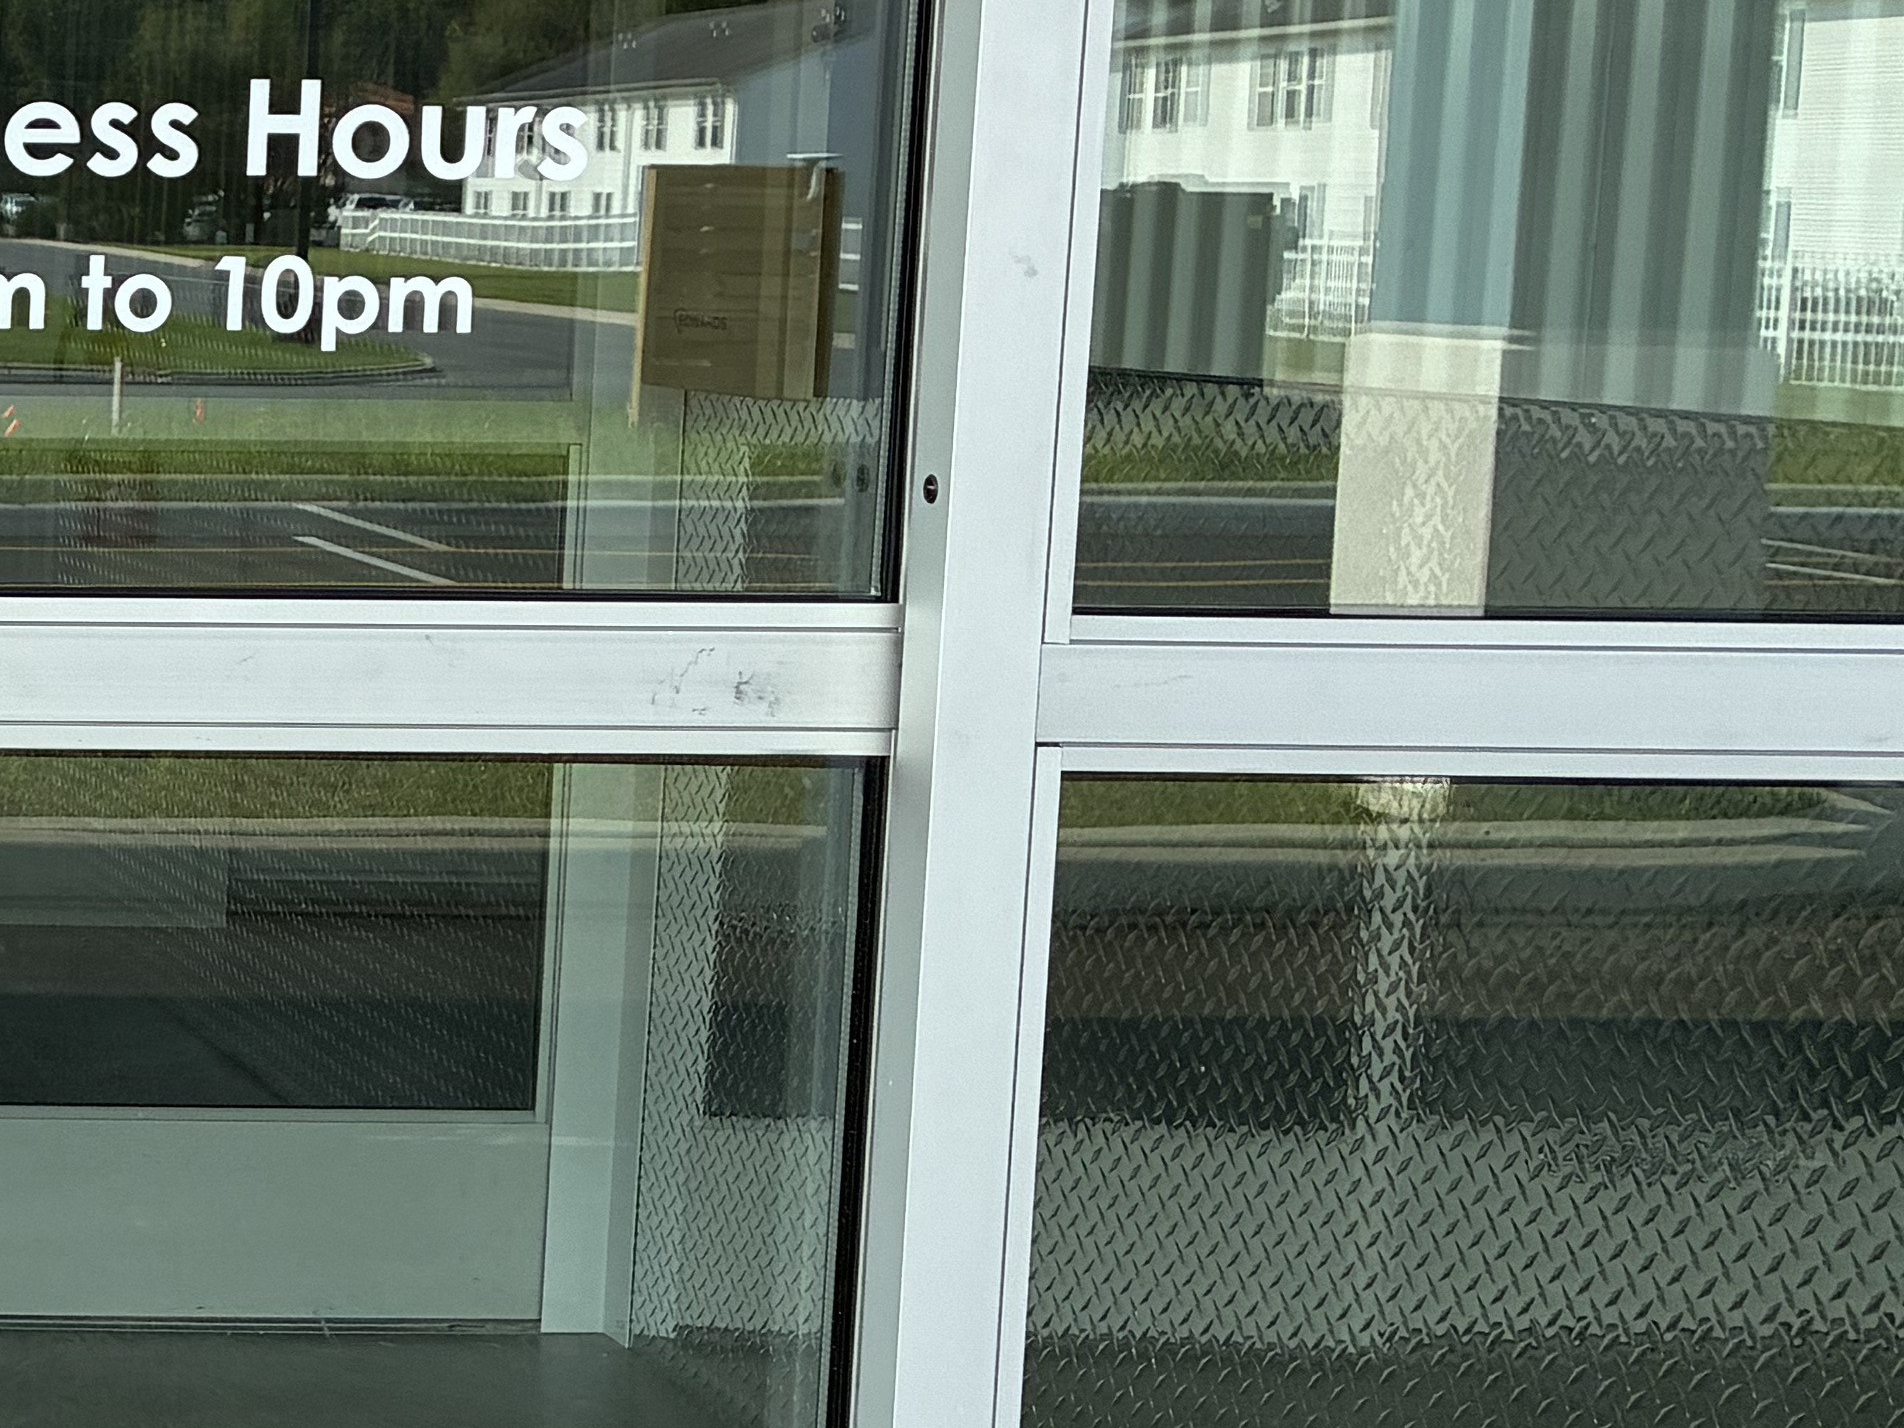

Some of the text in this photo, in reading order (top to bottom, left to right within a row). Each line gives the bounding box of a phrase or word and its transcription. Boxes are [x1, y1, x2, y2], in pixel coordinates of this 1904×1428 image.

[246, 79, 593, 185] Hours
[81, 254, 172, 333] to
[216, 254, 473, 352] 10pm
